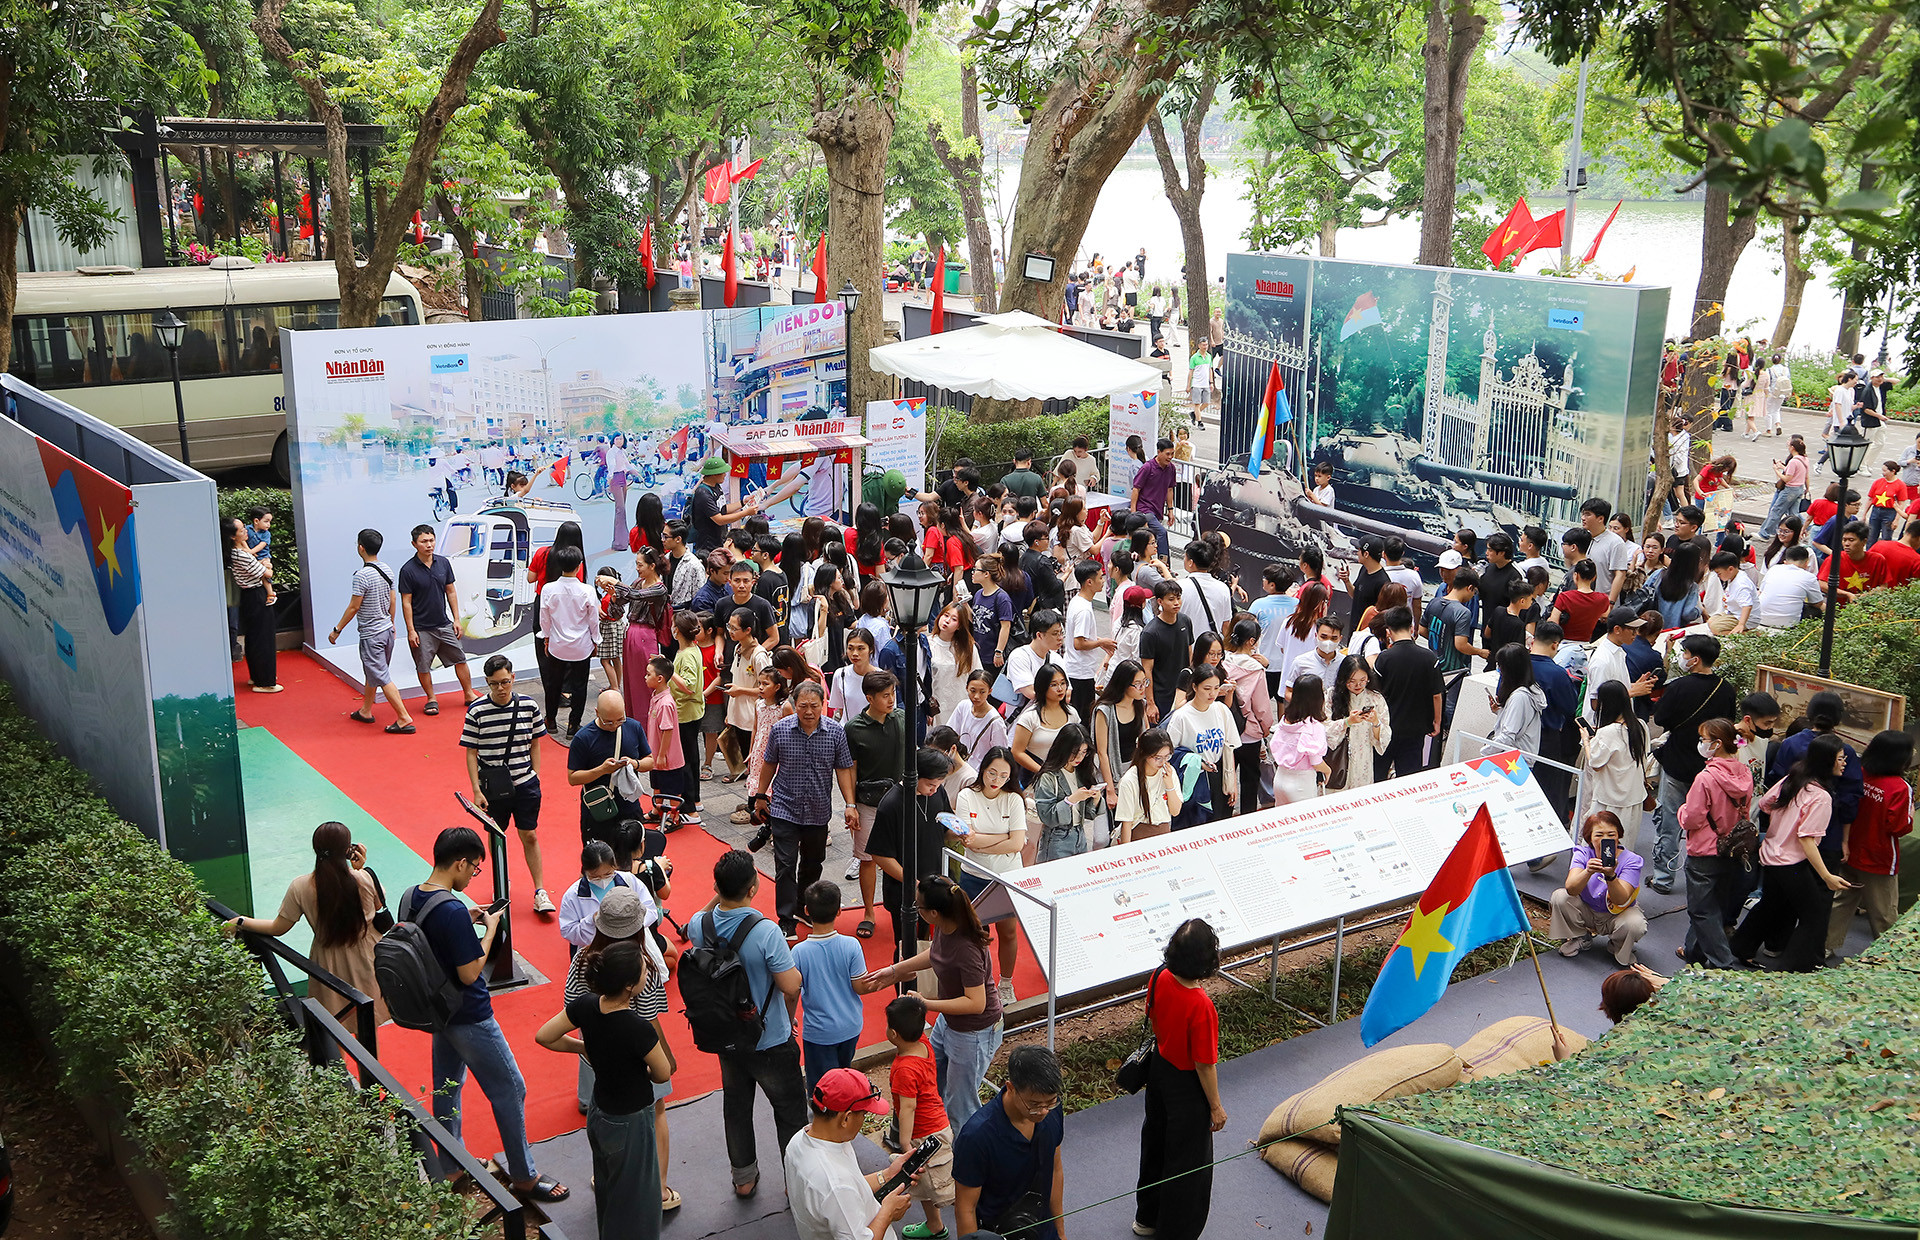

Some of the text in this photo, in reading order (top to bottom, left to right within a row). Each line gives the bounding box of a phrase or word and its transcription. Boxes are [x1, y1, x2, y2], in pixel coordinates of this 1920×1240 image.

[1256, 279, 1294, 294] Nhân Dân
[326, 359, 384, 375] Nhân Dân
[746, 421, 844, 442] SẠP BÁO Nhân Dân
[1086, 859, 1126, 875] NHỮNG
[1127, 850, 1156, 865] TRẬN
[1158, 844, 1188, 857] ĐÁNH
[1189, 836, 1218, 850] QUAN
[1218, 827, 1254, 842] TRỌNG
[1255, 821, 1277, 833] LÀM
[1278, 816, 1298, 827] NÊN
[1299, 810, 1316, 822] ĐẠI
[1317, 803, 1350, 817] THẮNG
[1350, 798, 1371, 809] MÙA
[1371, 792, 1397, 804] XUÂN
[1397, 786, 1418, 798] NĂM
[1418, 781, 1439, 792] 1975
